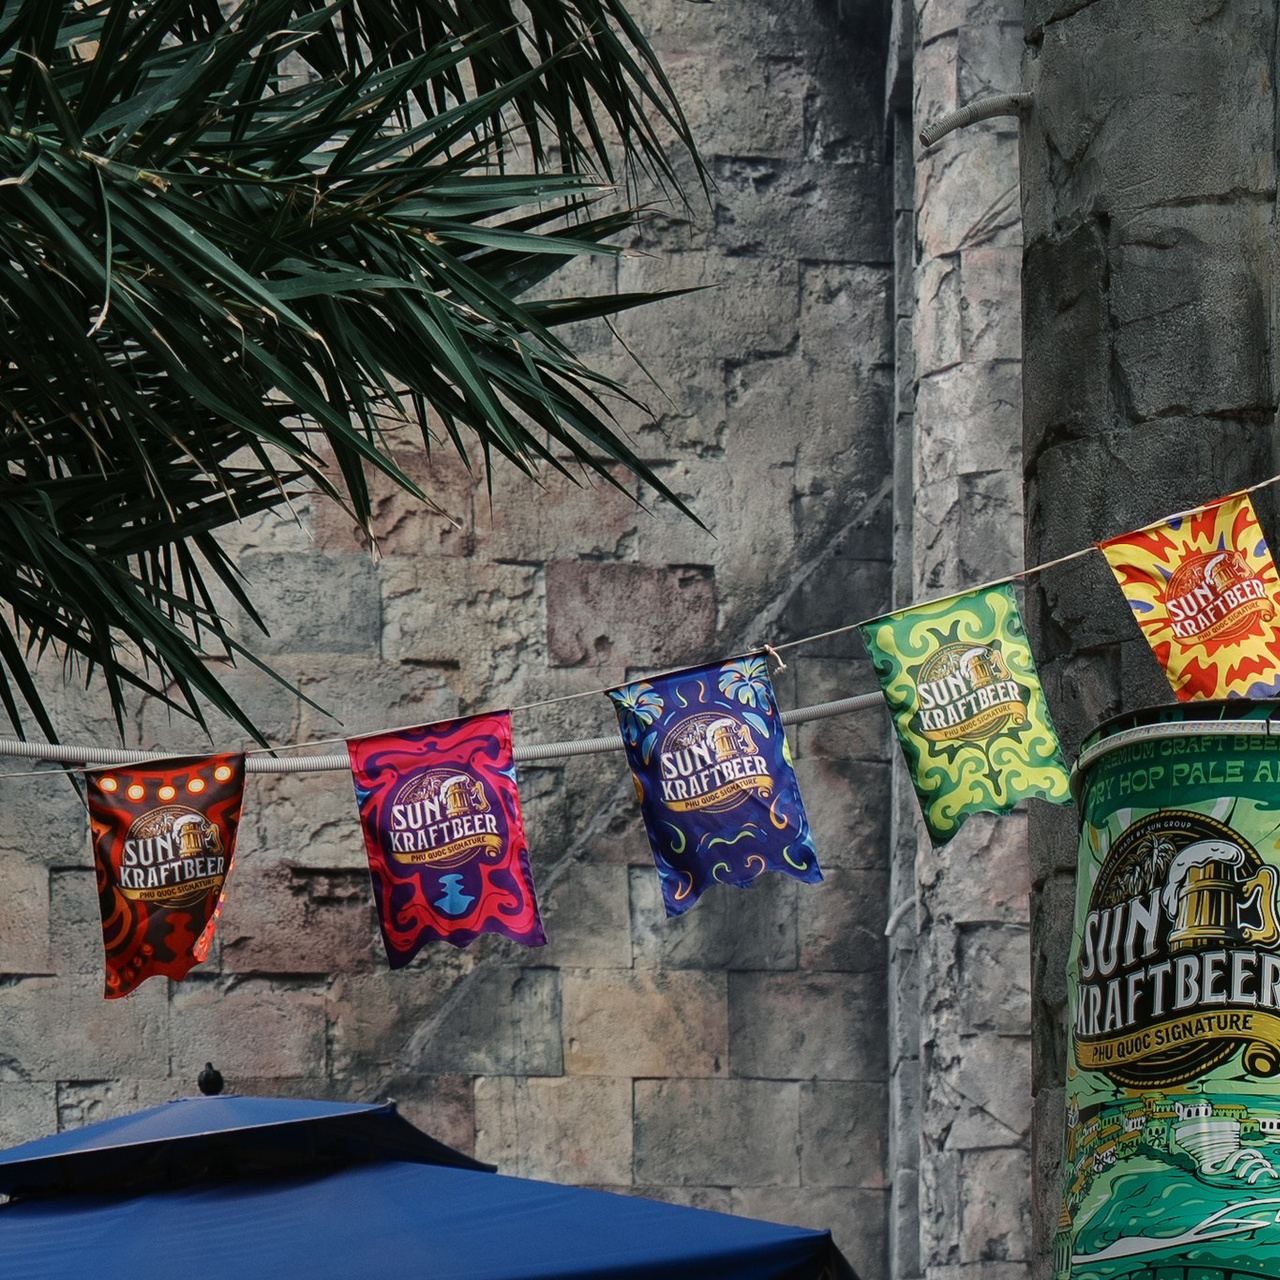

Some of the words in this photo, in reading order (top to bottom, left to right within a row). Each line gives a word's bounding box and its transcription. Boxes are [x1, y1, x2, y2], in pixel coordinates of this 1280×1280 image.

[1166, 581, 1215, 621] SUN
[1171, 579, 1268, 638] KRAFTBEER
[1197, 631, 1211, 641] PHU
[1212, 621, 1228, 635] QUOC
[1229, 601, 1260, 623] SIGNATURE
[917, 670, 968, 709] SUN
[919, 680, 1022, 731] KRAFTBEER
[944, 729, 959, 737] PHU
[960, 721, 977, 732] QUOC
[978, 704, 1011, 724] SIGNATURE
[660, 740, 713, 779] SUN
[1098, 742, 1155, 773] PREMIUM
[1160, 736, 1228, 756] CRAFT
[661, 756, 770, 800] KRAFTBEER
[685, 801, 699, 809] PHU
[701, 794, 720, 804] QUOC
[721, 777, 758, 799] SIGNATURE
[1089, 775, 1116, 809] DRY
[1119, 763, 1165, 796] HOP
[1172, 760, 1245, 786] PALE
[392, 796, 442, 830] SUN
[124, 832, 175, 866] SUN
[389, 814, 499, 852] KRAFTBEER
[411, 853, 426, 862] PHU
[428, 850, 446, 859] QUOC
[447, 836, 487, 855] SIGNATURE
[1119, 836, 1135, 853] MADE
[1147, 822, 1161, 832] SUN
[1163, 820, 1192, 829] GROUP
[119, 857, 224, 888] KRAFTBEER
[139, 890, 155, 899] PHU
[156, 888, 177, 897] QUOC
[1081, 887, 1161, 979] SUN
[1092, 1044, 1113, 1063] PHU
[1117, 1034, 1151, 1058] QUOC
[1155, 1014, 1253, 1045] SIGNATURE
